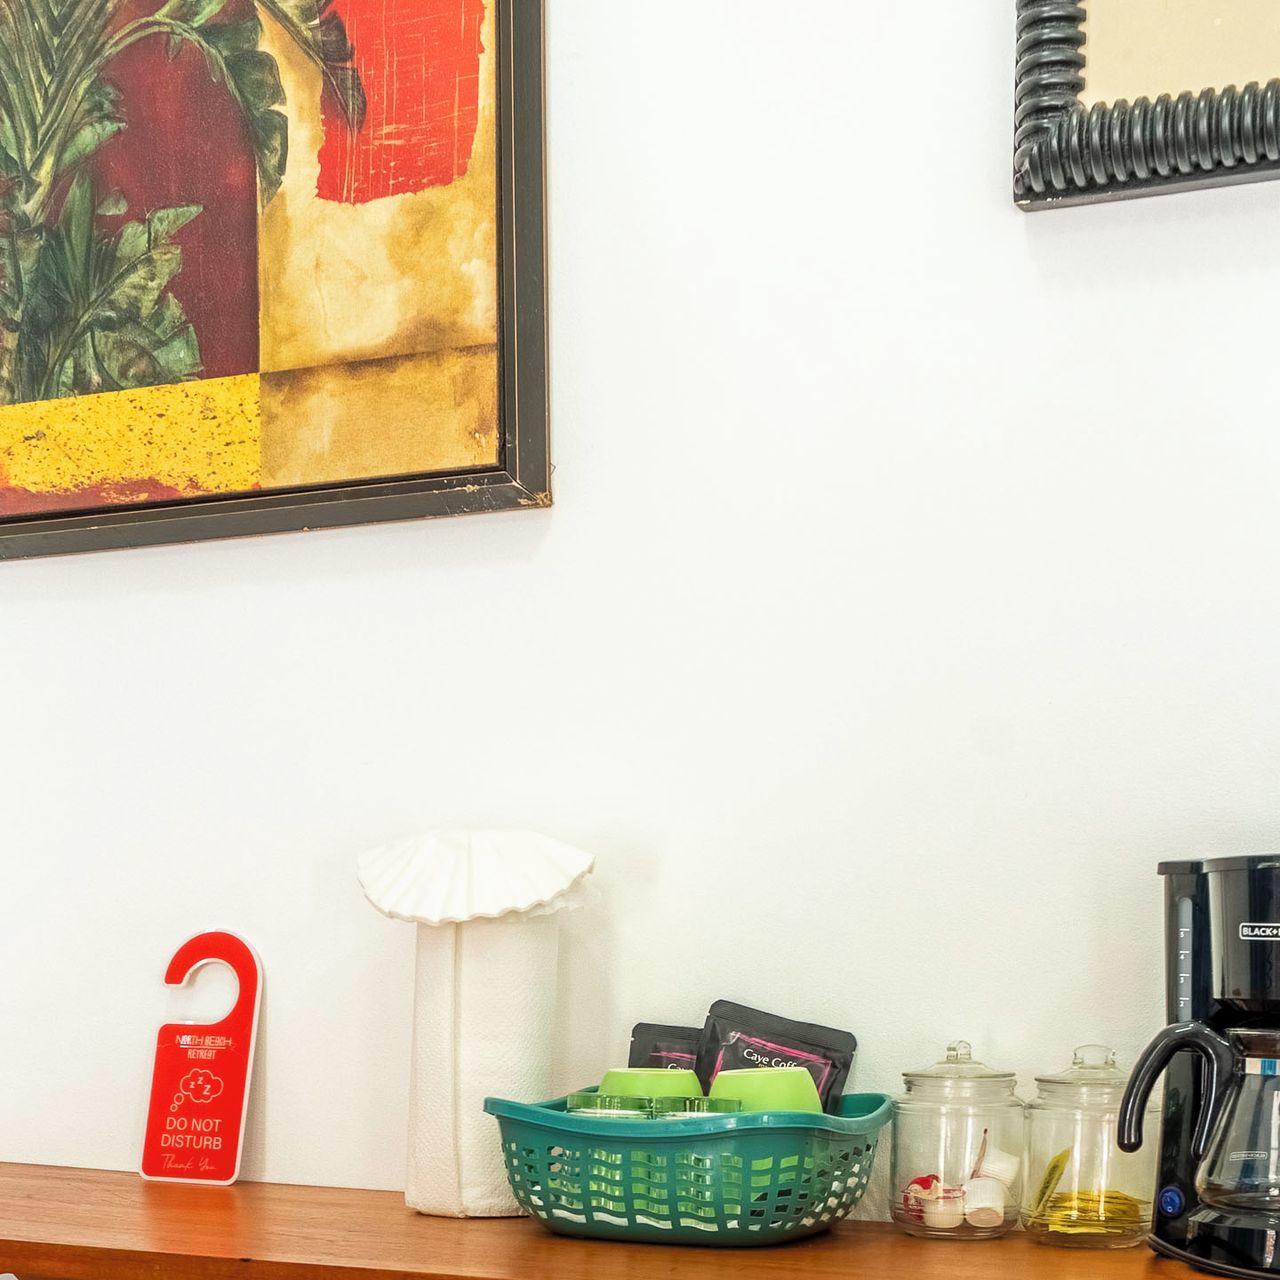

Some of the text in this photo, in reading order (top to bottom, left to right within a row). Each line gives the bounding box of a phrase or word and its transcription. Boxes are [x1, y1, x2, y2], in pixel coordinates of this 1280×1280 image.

[205, 1035, 233, 1047] BEACH
[187, 1048, 217, 1060] RETREAT
[743, 1048, 769, 1065] Caye
[771, 1057, 798, 1068] Coff
[166, 1116, 222, 1133] DO NOT
[160, 1133, 222, 1150] DISTURB
[160, 1153, 217, 1172] Thank You
